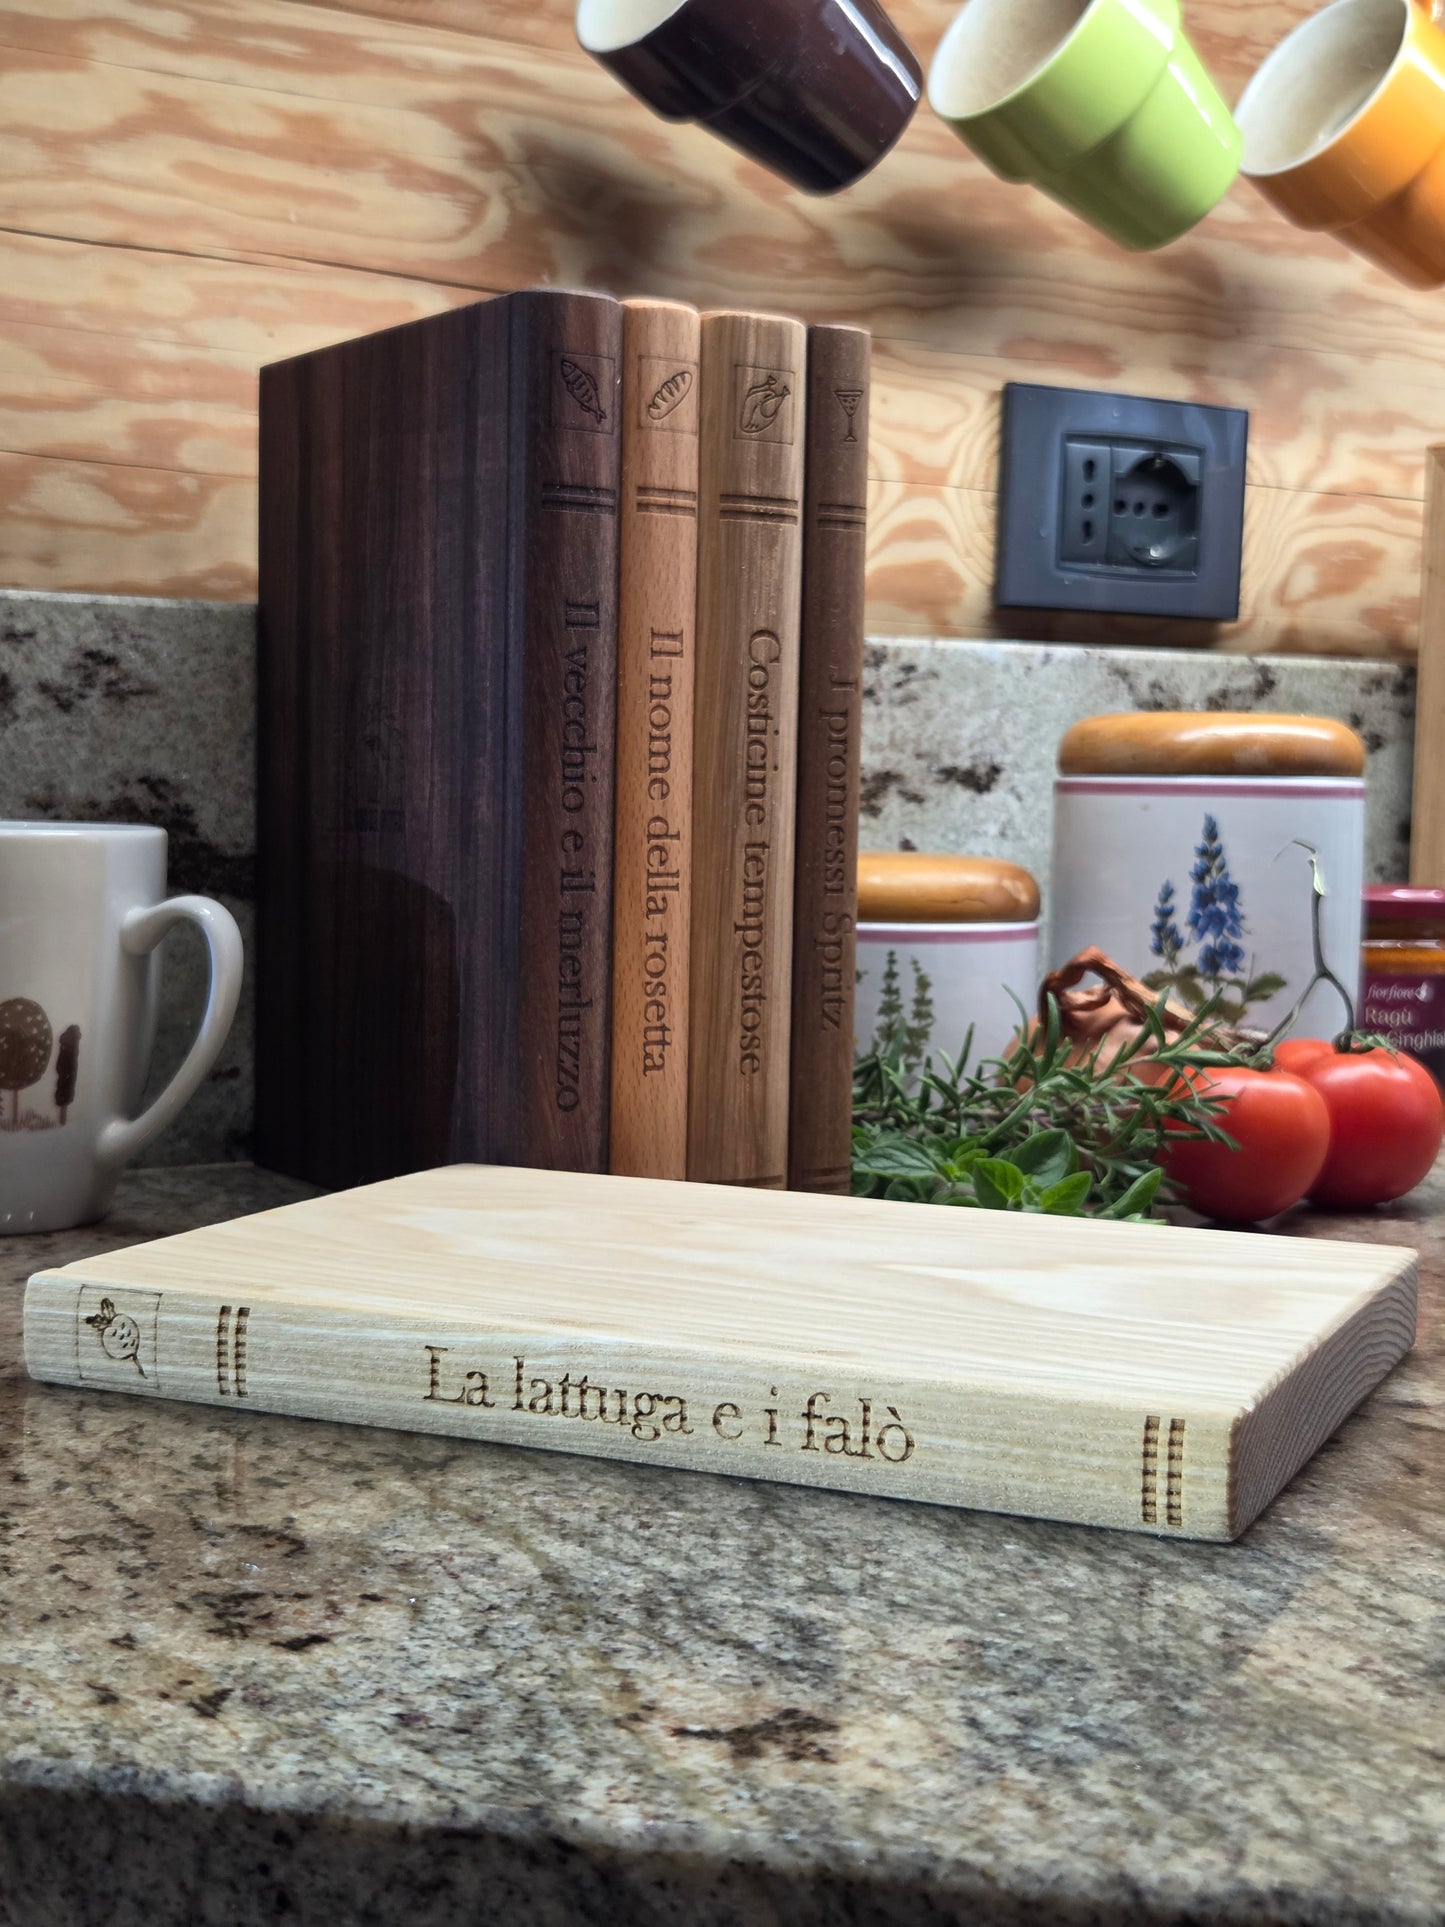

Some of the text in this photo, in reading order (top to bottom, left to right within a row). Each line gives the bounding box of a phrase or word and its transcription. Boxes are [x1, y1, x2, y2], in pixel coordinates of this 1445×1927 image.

[556, 600, 600, 1113] Il vecchio e il merluzzo
[642, 627, 684, 1077] Il nome della rosetta
[734, 629, 781, 1076] Costicine tempestose
[818, 708, 855, 896] promessi
[814, 912, 854, 1032] Spritz
[1365, 1006, 1413, 1027] Ragù
[423, 1345, 917, 1463] La lattuga e i falò
